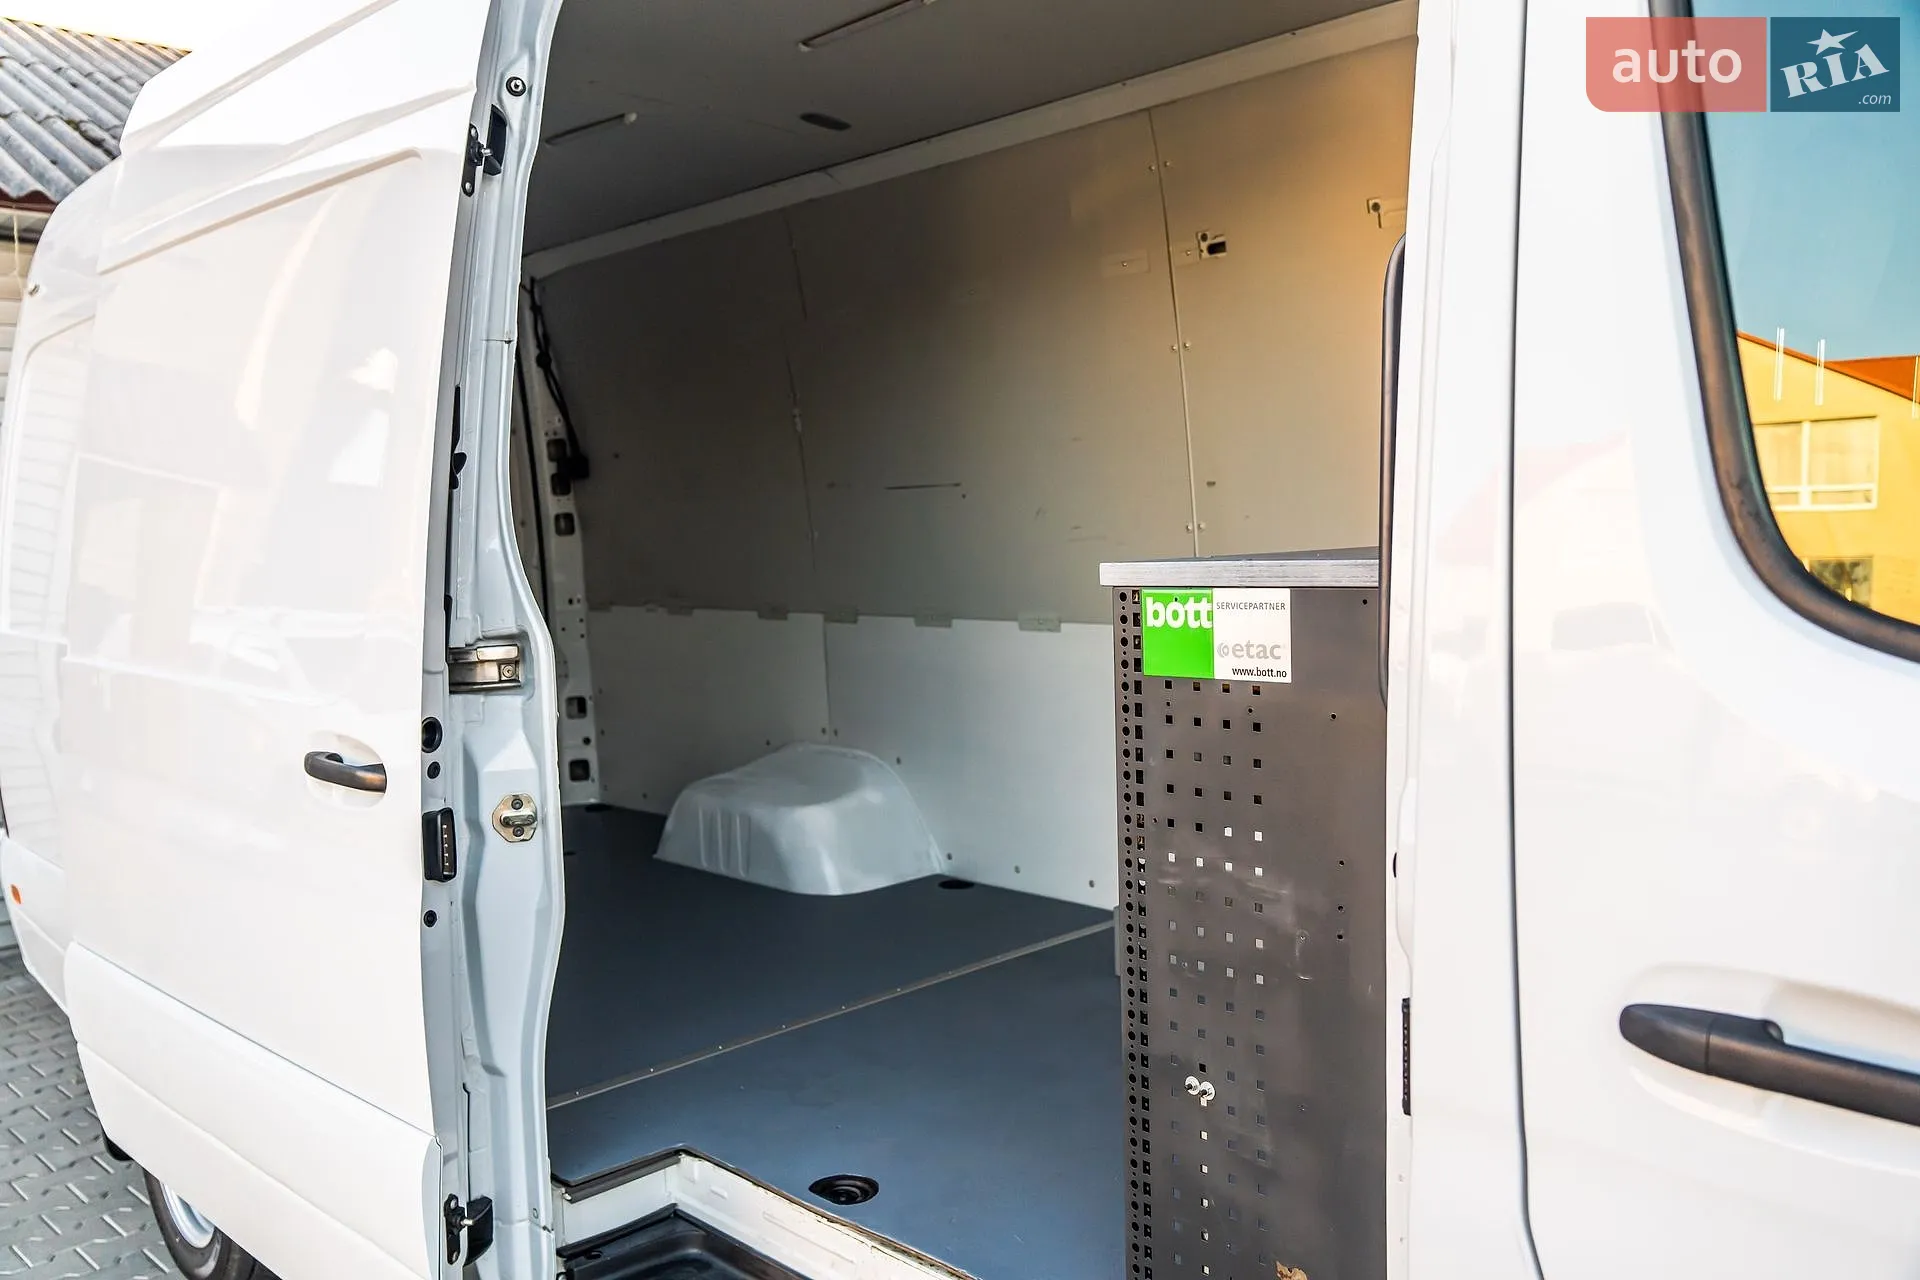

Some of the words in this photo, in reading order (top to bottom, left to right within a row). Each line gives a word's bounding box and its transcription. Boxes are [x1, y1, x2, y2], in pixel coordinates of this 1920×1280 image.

[1145, 597, 1213, 628] bott
[1216, 602, 1286, 611] SERVICEPARTNER
[1231, 641, 1282, 660] etac
[1231, 667, 1287, 678] www.bott.no
